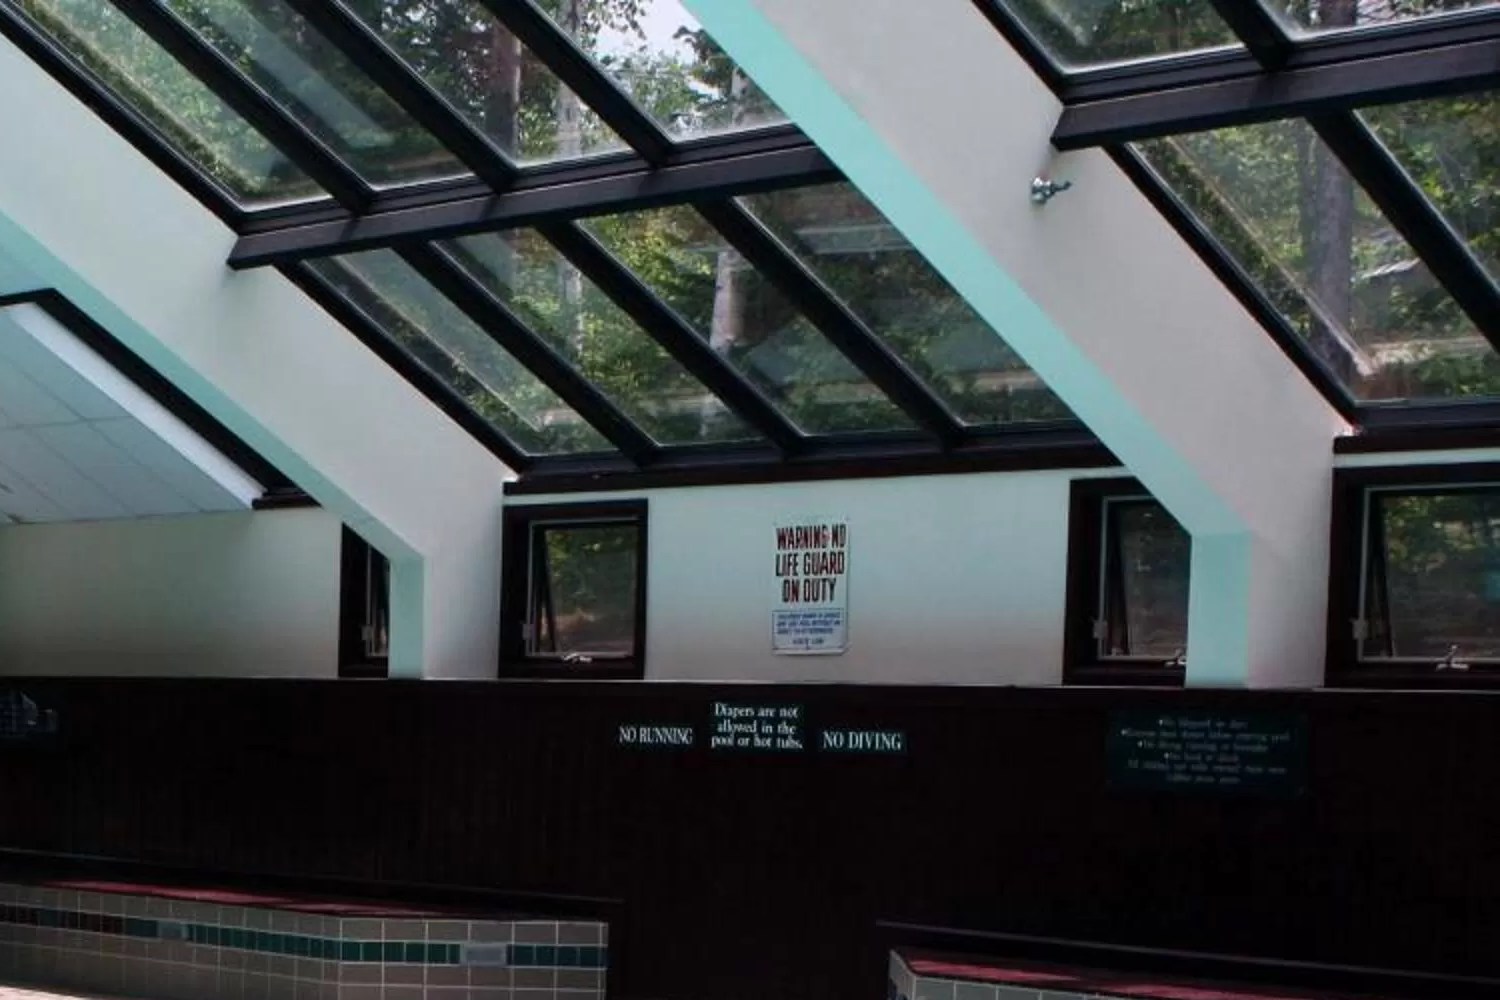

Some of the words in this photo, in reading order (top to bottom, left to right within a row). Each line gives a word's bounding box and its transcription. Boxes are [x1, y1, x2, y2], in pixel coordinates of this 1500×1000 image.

[776, 525, 830, 550] WARNING
[831, 523, 846, 548] NO
[775, 553, 799, 577] LIFE
[803, 551, 845, 576] GUARD
[782, 578, 799, 603] ON
[803, 577, 836, 602] DUTY
[714, 702, 755, 719] Diapers
[757, 707, 776, 718] are
[779, 705, 799, 718] not
[619, 725, 637, 744] NO
[639, 726, 693, 745] RUNNING
[717, 719, 757, 733] allowed
[761, 720, 773, 734] in
[777, 721, 796, 735] the
[711, 734, 735, 749] pool
[737, 736, 750, 747] or
[753, 734, 772, 747] hot
[822, 730, 844, 749] NO
[848, 731, 901, 750] DIVING
